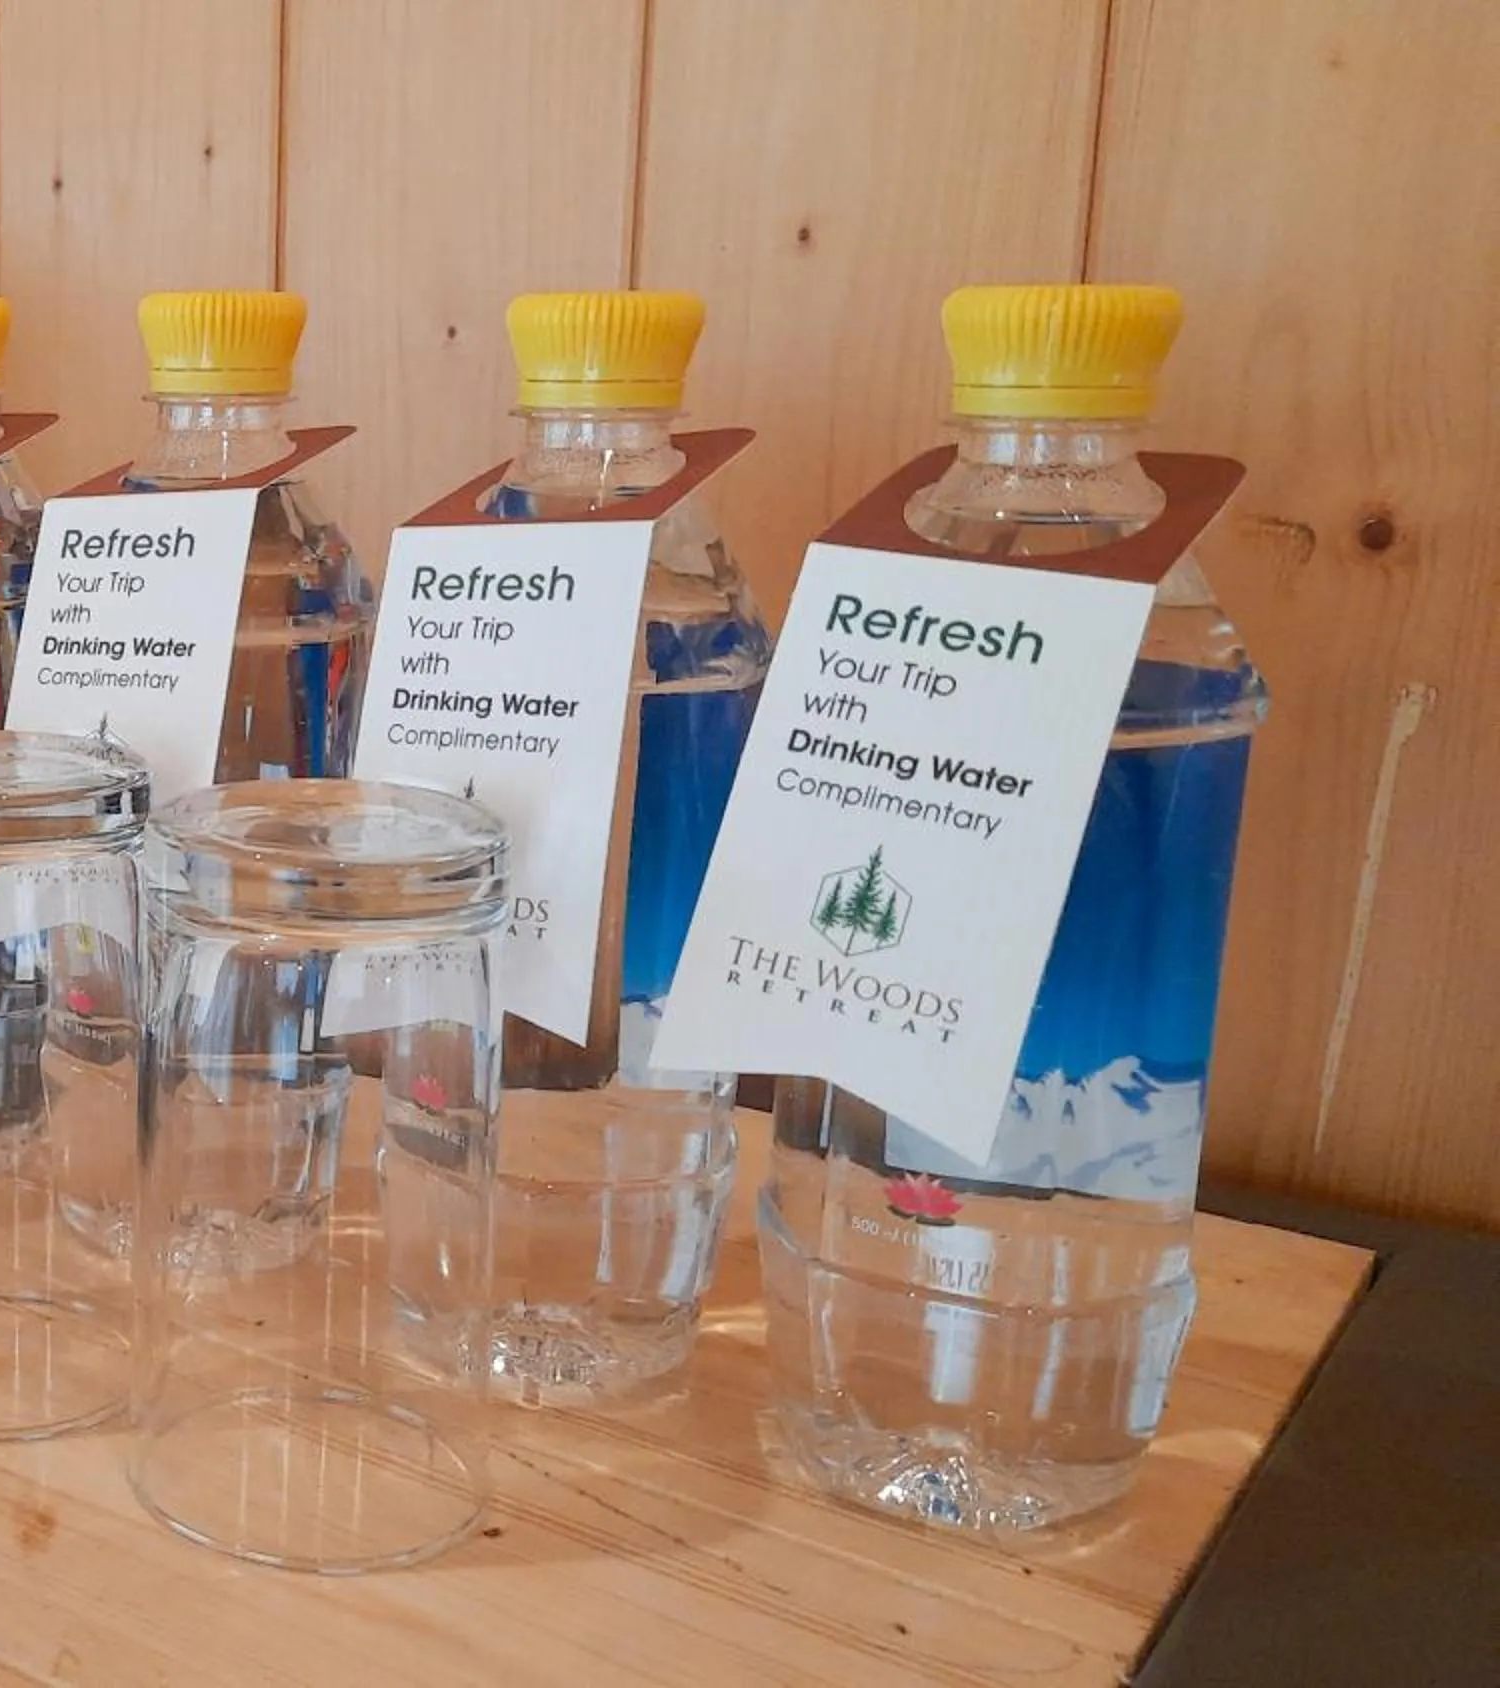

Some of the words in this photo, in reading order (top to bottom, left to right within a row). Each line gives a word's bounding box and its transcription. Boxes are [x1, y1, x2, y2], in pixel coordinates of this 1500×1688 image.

[60, 526, 195, 559] Refresh
[57, 572, 104, 593] Your
[109, 571, 146, 598] Trip
[411, 565, 576, 602] Refresh
[51, 603, 92, 624] with
[825, 593, 1044, 664] Refresh
[407, 615, 463, 640] Your
[472, 615, 516, 646] Trip
[42, 636, 126, 661] Drinking
[132, 637, 197, 657] Water
[400, 651, 450, 675] with
[37, 667, 180, 695] Complimentary
[818, 647, 891, 686] Your
[900, 661, 957, 699] Trip
[392, 687, 494, 719] Drinking
[501, 692, 581, 718] Water
[803, 691, 868, 723] with
[387, 723, 561, 758] Complimentary
[787, 728, 920, 780] Drinking
[931, 755, 1034, 798] Water
[776, 767, 1002, 839] Complimentary
[729, 935, 803, 981] THE
[817, 958, 964, 1024] WOODS
[726, 969, 956, 1044] RETREAT
